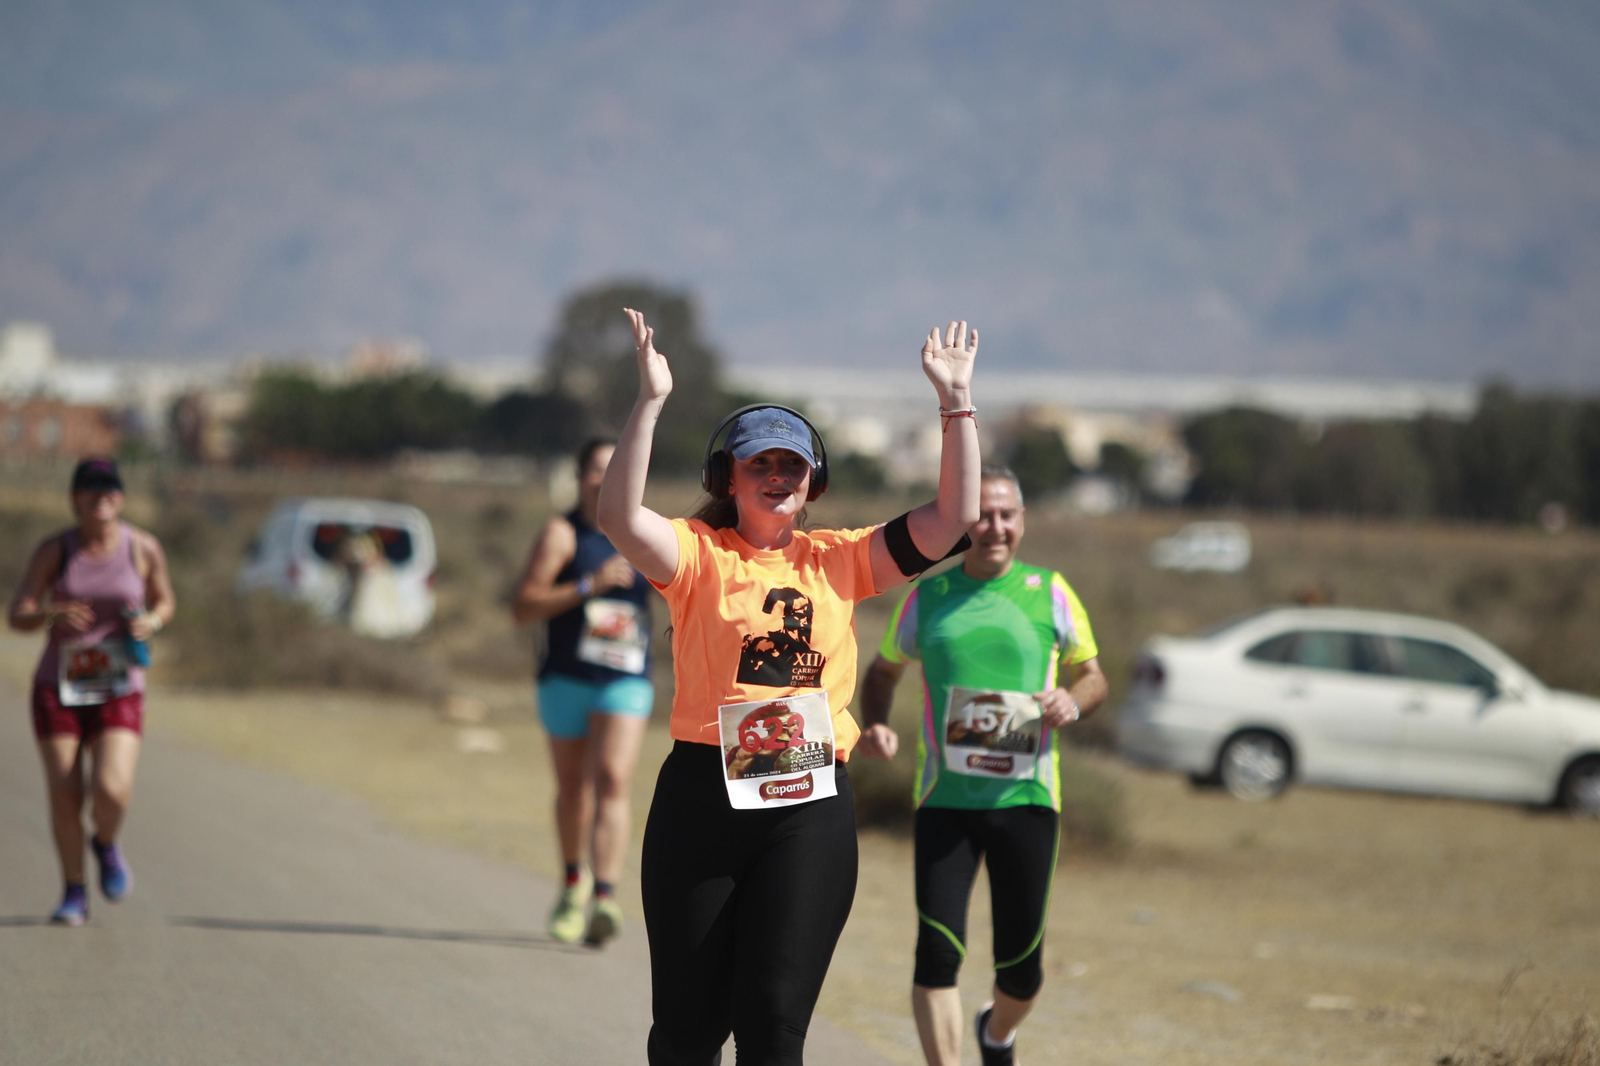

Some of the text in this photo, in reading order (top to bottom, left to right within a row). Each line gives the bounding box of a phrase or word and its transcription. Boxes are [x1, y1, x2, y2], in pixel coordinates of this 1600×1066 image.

[962, 702, 1018, 735] 157
[738, 713, 806, 753] 622
[790, 741, 824, 755] XIII
[790, 749, 825, 760] CARRERA
[791, 754, 824, 764] POPULAR
[766, 779, 810, 796] Caparrós
